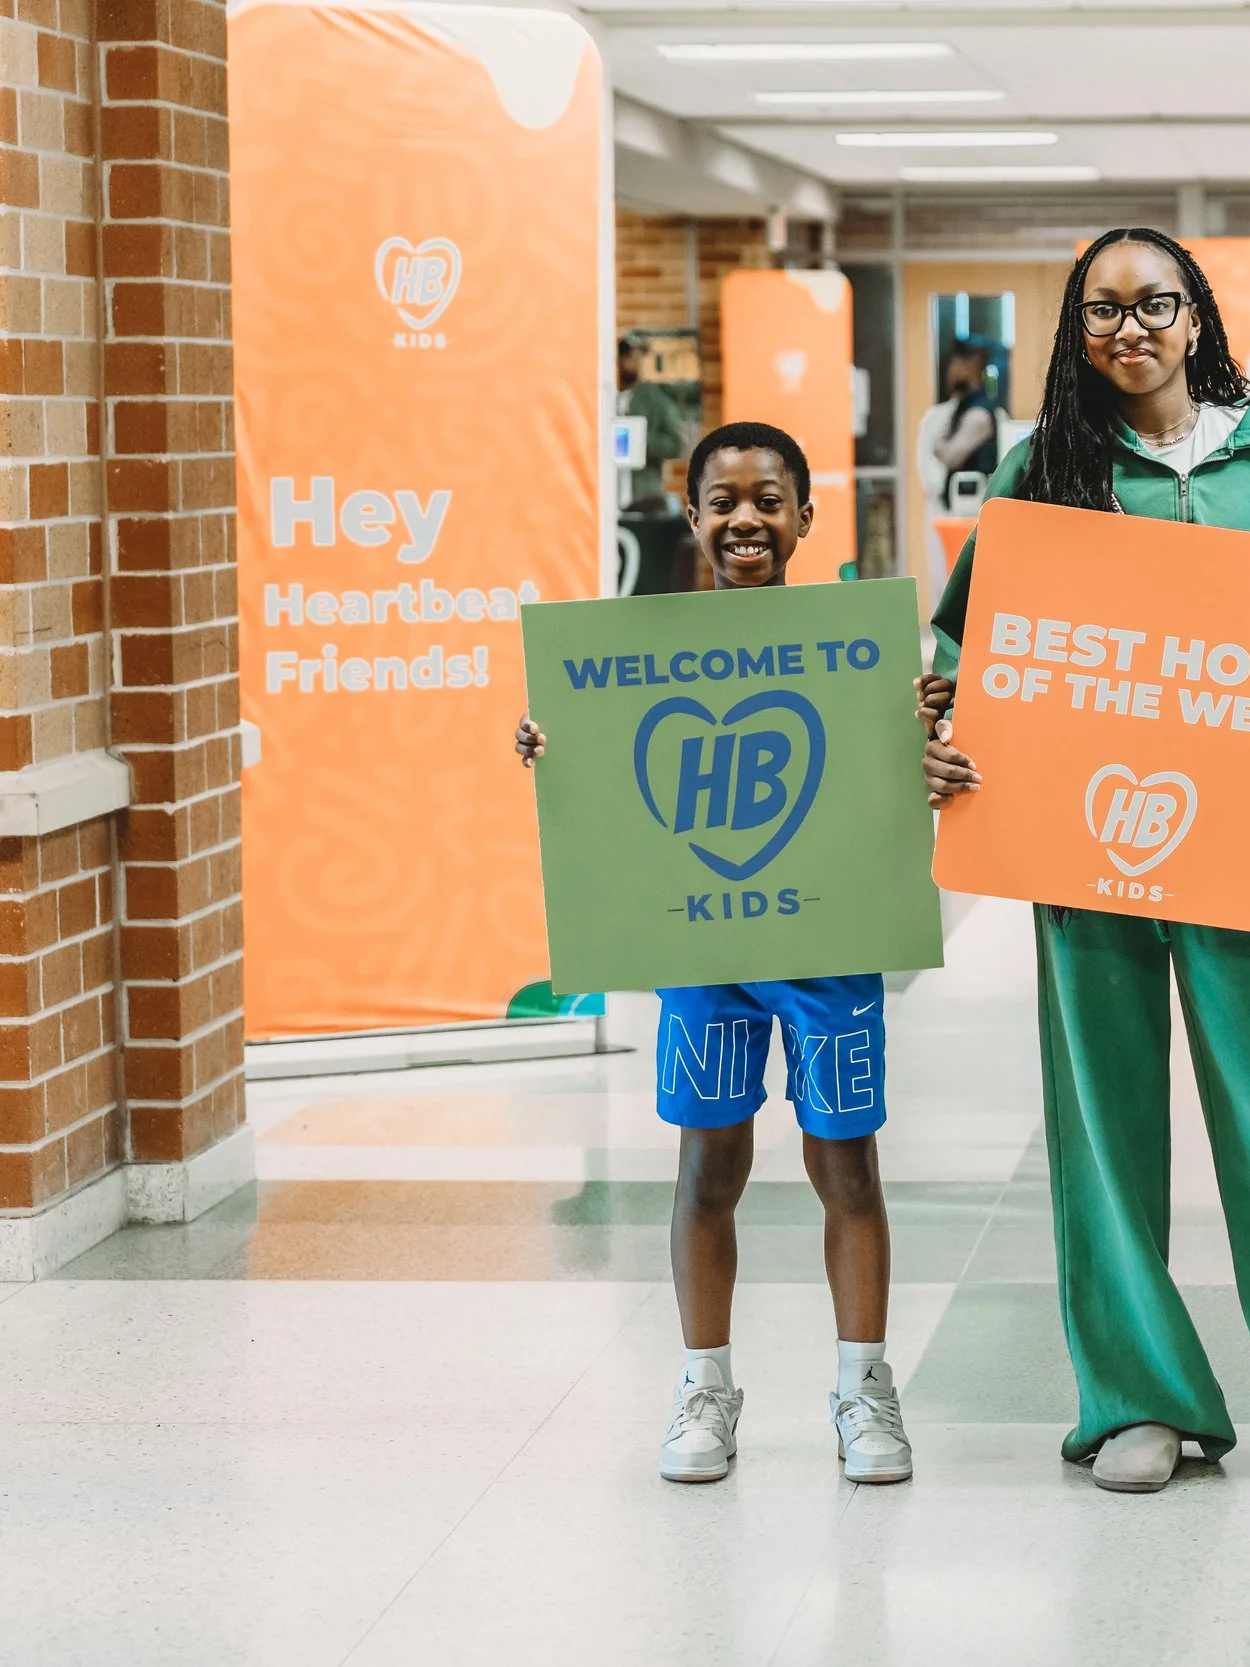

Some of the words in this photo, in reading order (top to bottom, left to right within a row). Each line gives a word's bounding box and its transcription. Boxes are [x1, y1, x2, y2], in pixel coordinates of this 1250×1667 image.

[391, 256, 447, 305] HB
[393, 332, 446, 349] KIDS
[270, 476, 453, 564] Hey
[264, 579, 540, 627] Heartbeat
[563, 643, 805, 689] WELCOME
[816, 638, 880, 672] TO
[989, 612, 1147, 671] BEST
[265, 644, 489, 694] Friends!
[982, 664, 1053, 702] OF
[1064, 673, 1162, 720] THE
[674, 730, 792, 835] HB
[1099, 788, 1177, 848] HB
[686, 888, 800, 922] KIDS
[1096, 878, 1164, 903] KIDS
[661, 1014, 874, 1114] NIKE
